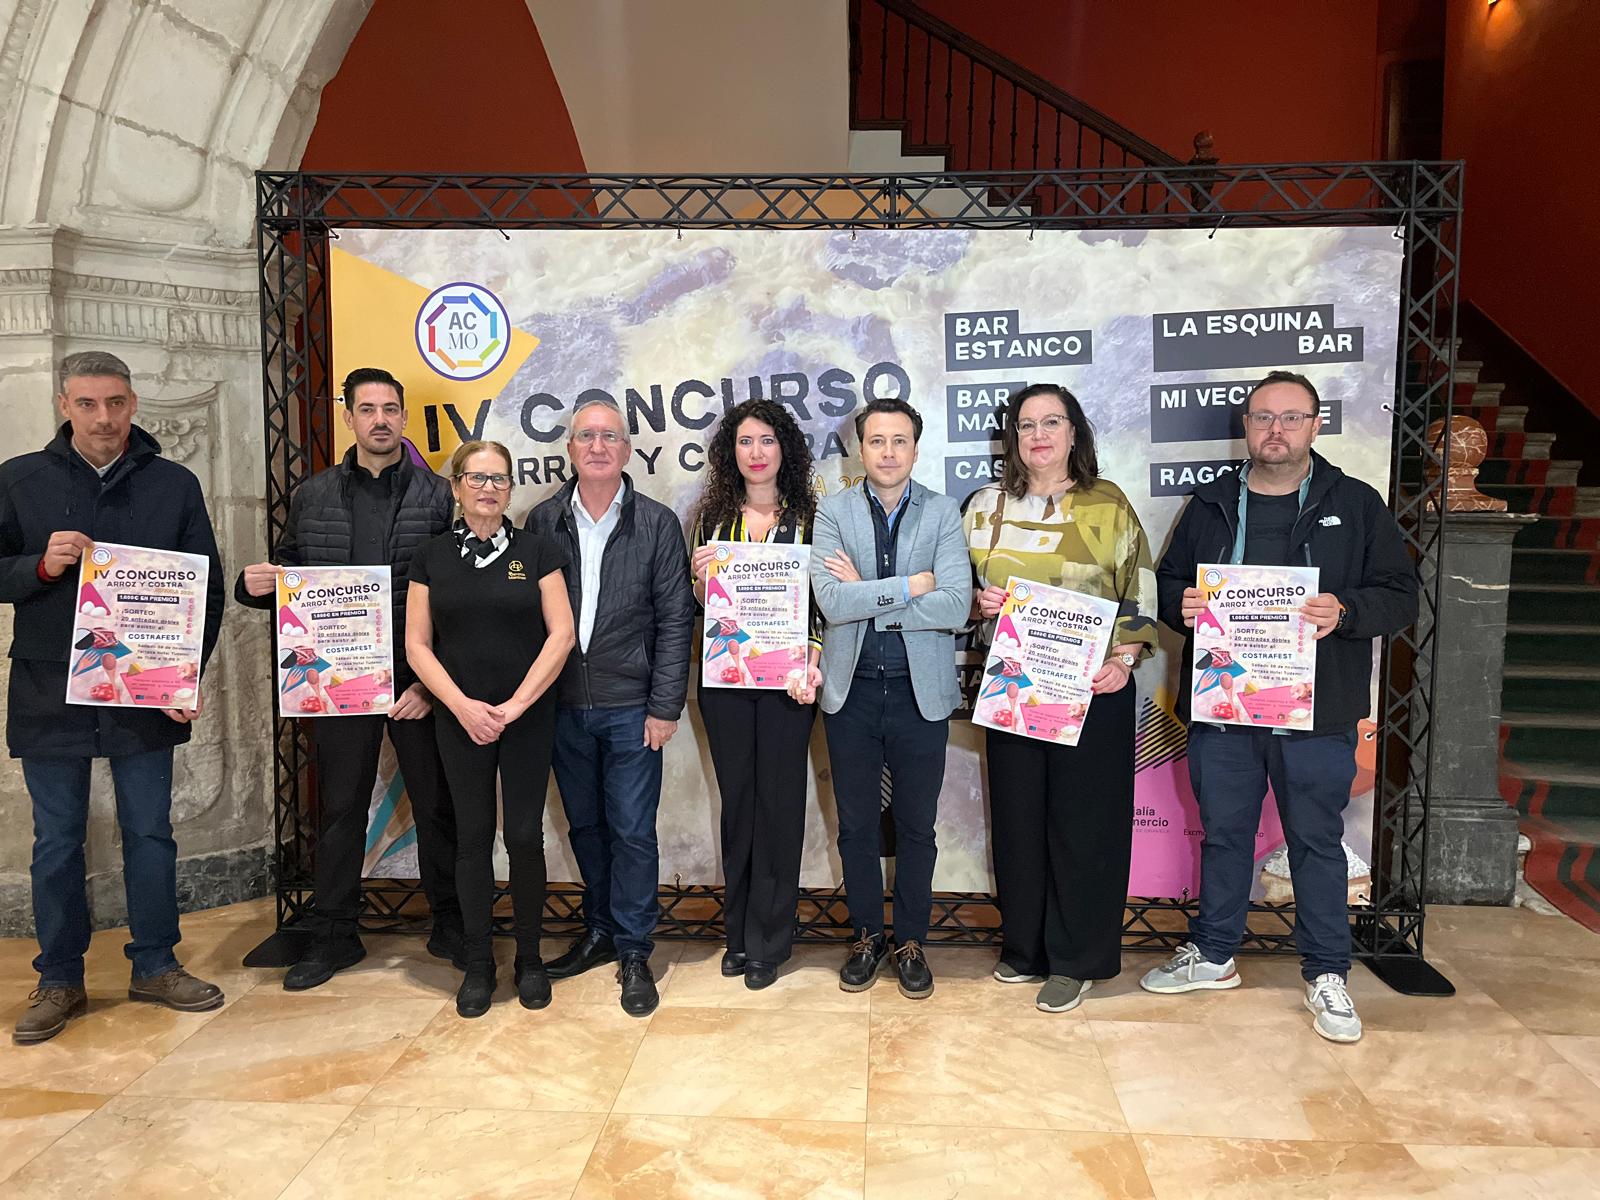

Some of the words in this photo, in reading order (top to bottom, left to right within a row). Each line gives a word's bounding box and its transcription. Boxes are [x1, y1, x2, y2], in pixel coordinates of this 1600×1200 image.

[449, 312, 477, 330] AC
[955, 317, 1009, 336] BAR
[1163, 318, 1198, 337] LA
[1206, 311, 1323, 337] ESQUINA
[449, 332, 478, 350] MO
[955, 336, 1082, 360] ESTANCO
[1298, 333, 1353, 354] BAR
[957, 388, 1010, 408] BAR
[1160, 389, 1187, 409] MI
[424, 399, 491, 452] IV
[635, 447, 662, 474] Y
[94, 569, 110, 580] IV
[115, 570, 196, 581] CONCURSO
[717, 565, 729, 574] IV
[733, 560, 800, 573] CONCURSO
[727, 573, 751, 581] ARROZ
[288, 592, 302, 602] IV
[307, 583, 380, 600] CONCURSO
[301, 599, 327, 608] ARROZ
[337, 594, 369, 604] COSTRA
[1208, 590, 1221, 601] IV
[1226, 586, 1306, 600] CONCURSO
[1257, 599, 1292, 607] COSTRA
[1012, 604, 1027, 614] IV
[1030, 606, 1103, 626] CONCURSO
[1021, 616, 1047, 625] ARROZ
[1057, 621, 1089, 632] COSTRA
[326, 644, 372, 654] COSTRAFEST
[1032, 667, 1077, 681] COSTRAFEST
